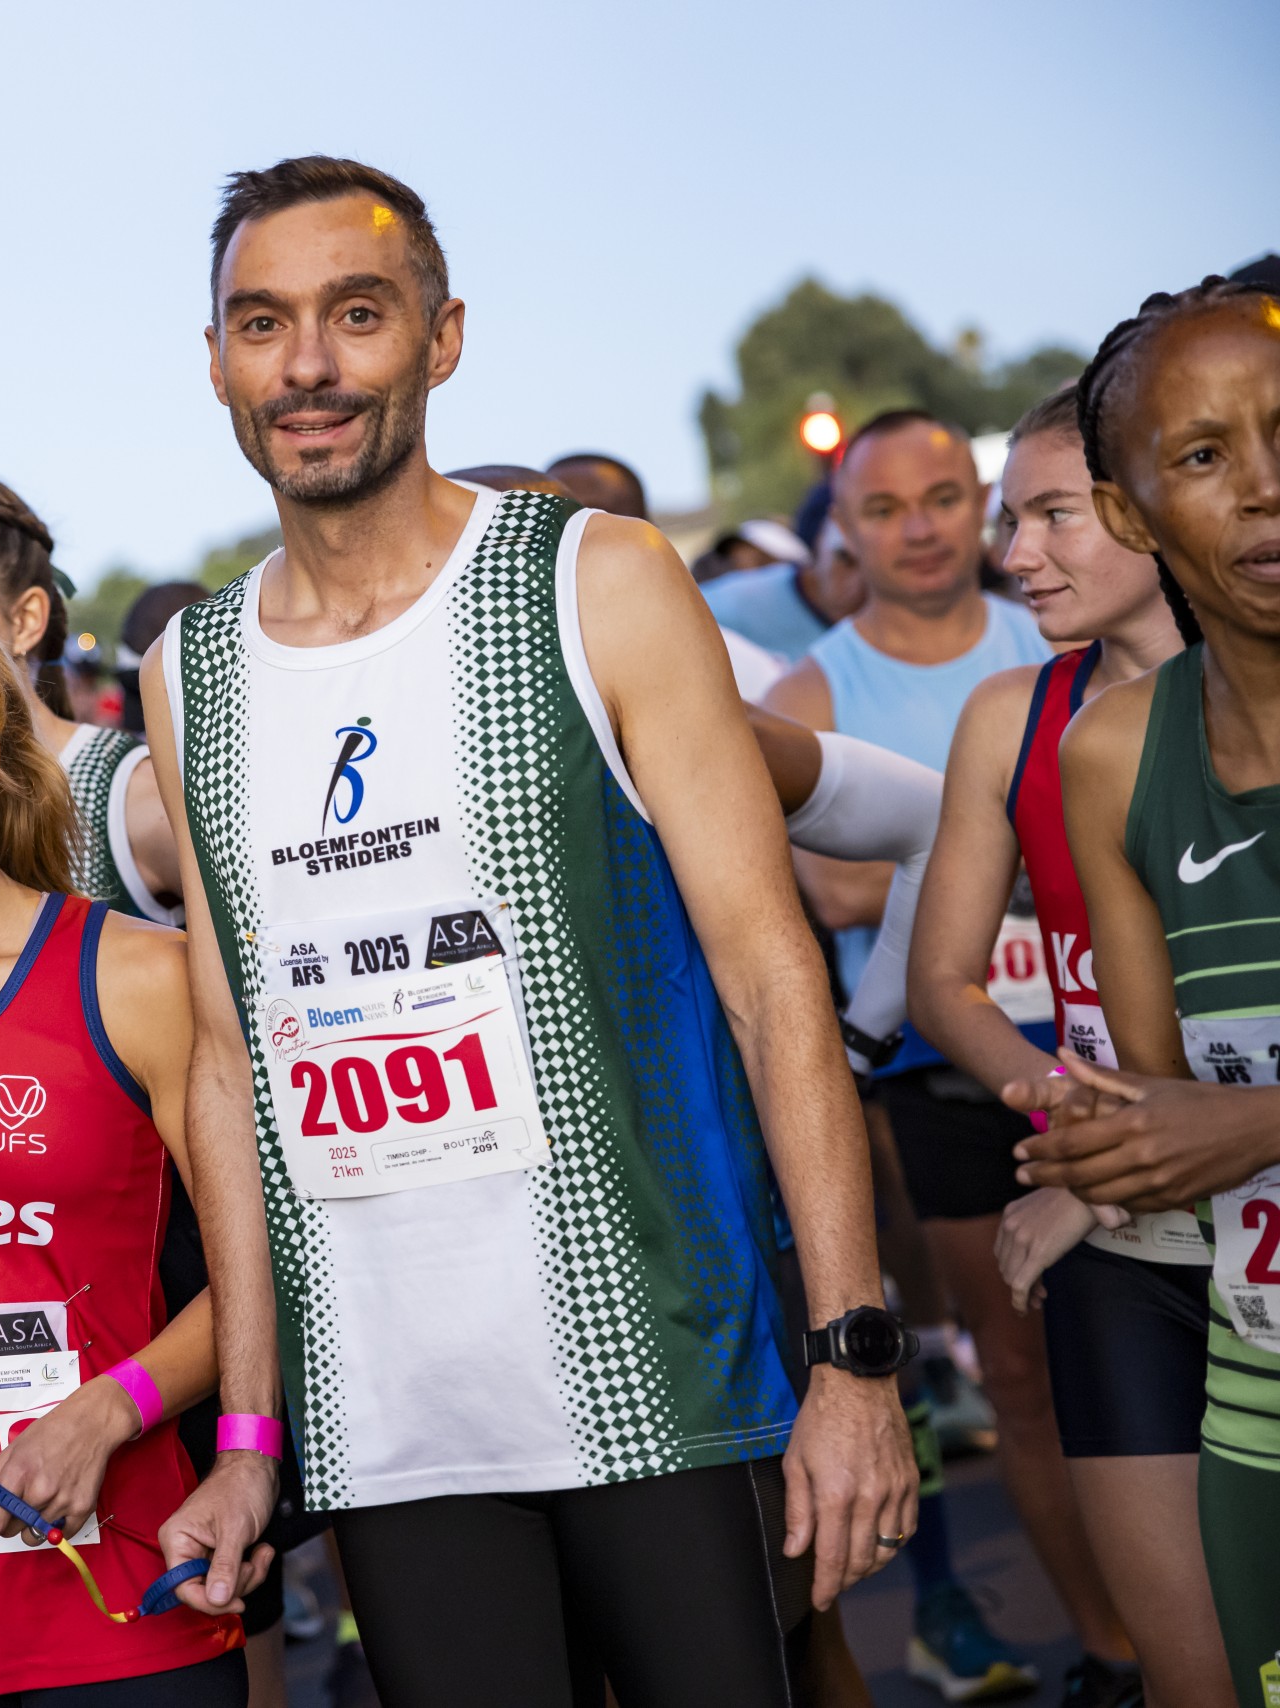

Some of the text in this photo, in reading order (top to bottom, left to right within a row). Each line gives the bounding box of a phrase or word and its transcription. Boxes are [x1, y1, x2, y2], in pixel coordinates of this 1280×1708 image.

[271, 816, 441, 866] BLOEMFONTEIN
[306, 841, 413, 876] STRIDERS
[432, 916, 492, 950] ASA
[289, 942, 318, 957] ASA
[344, 934, 411, 976] 2025
[280, 955, 329, 967] License issued by
[291, 964, 325, 987] AFS
[407, 982, 453, 996] BLOEMFONTEIN
[307, 1007, 364, 1028] Bloem
[1071, 1024, 1096, 1036] ASA
[1209, 1042, 1237, 1055] ASA
[290, 1032, 498, 1137] 2091
[329, 1146, 357, 1160] 2025
[386, 1148, 427, 1161] TIMING CHIP
[472, 1142, 499, 1154] 2091
[332, 1166, 364, 1178] 21km
